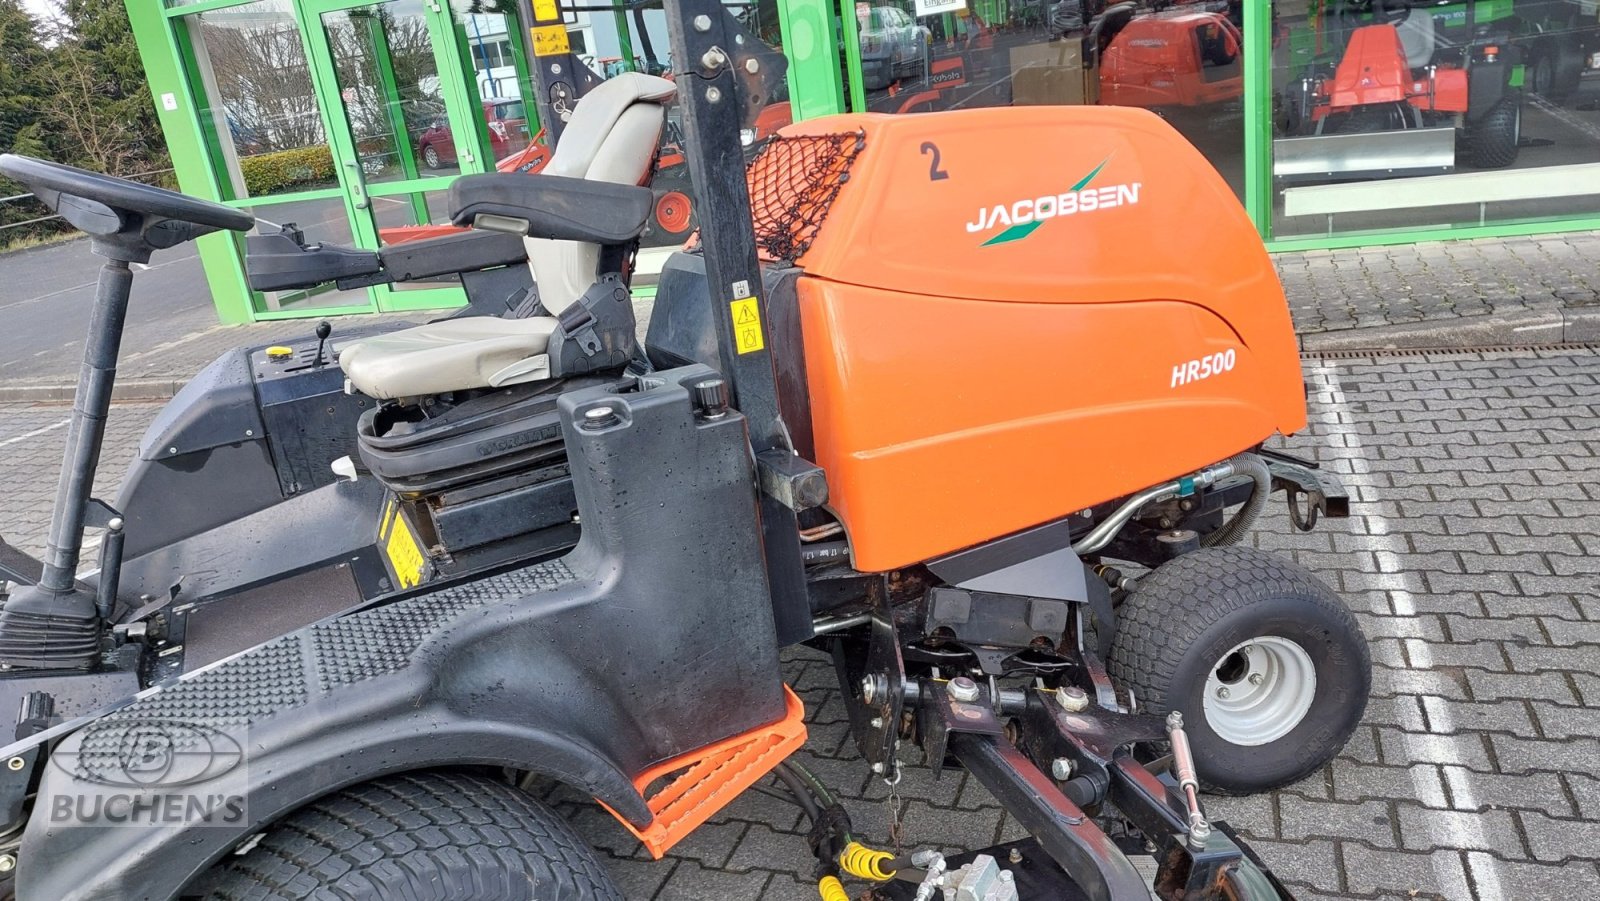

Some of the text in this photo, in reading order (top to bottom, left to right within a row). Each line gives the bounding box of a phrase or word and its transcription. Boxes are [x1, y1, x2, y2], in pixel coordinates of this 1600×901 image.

[920, 141, 950, 181] 2
[966, 182, 1140, 233] JACOBSEN
[1170, 348, 1236, 389] HR500
